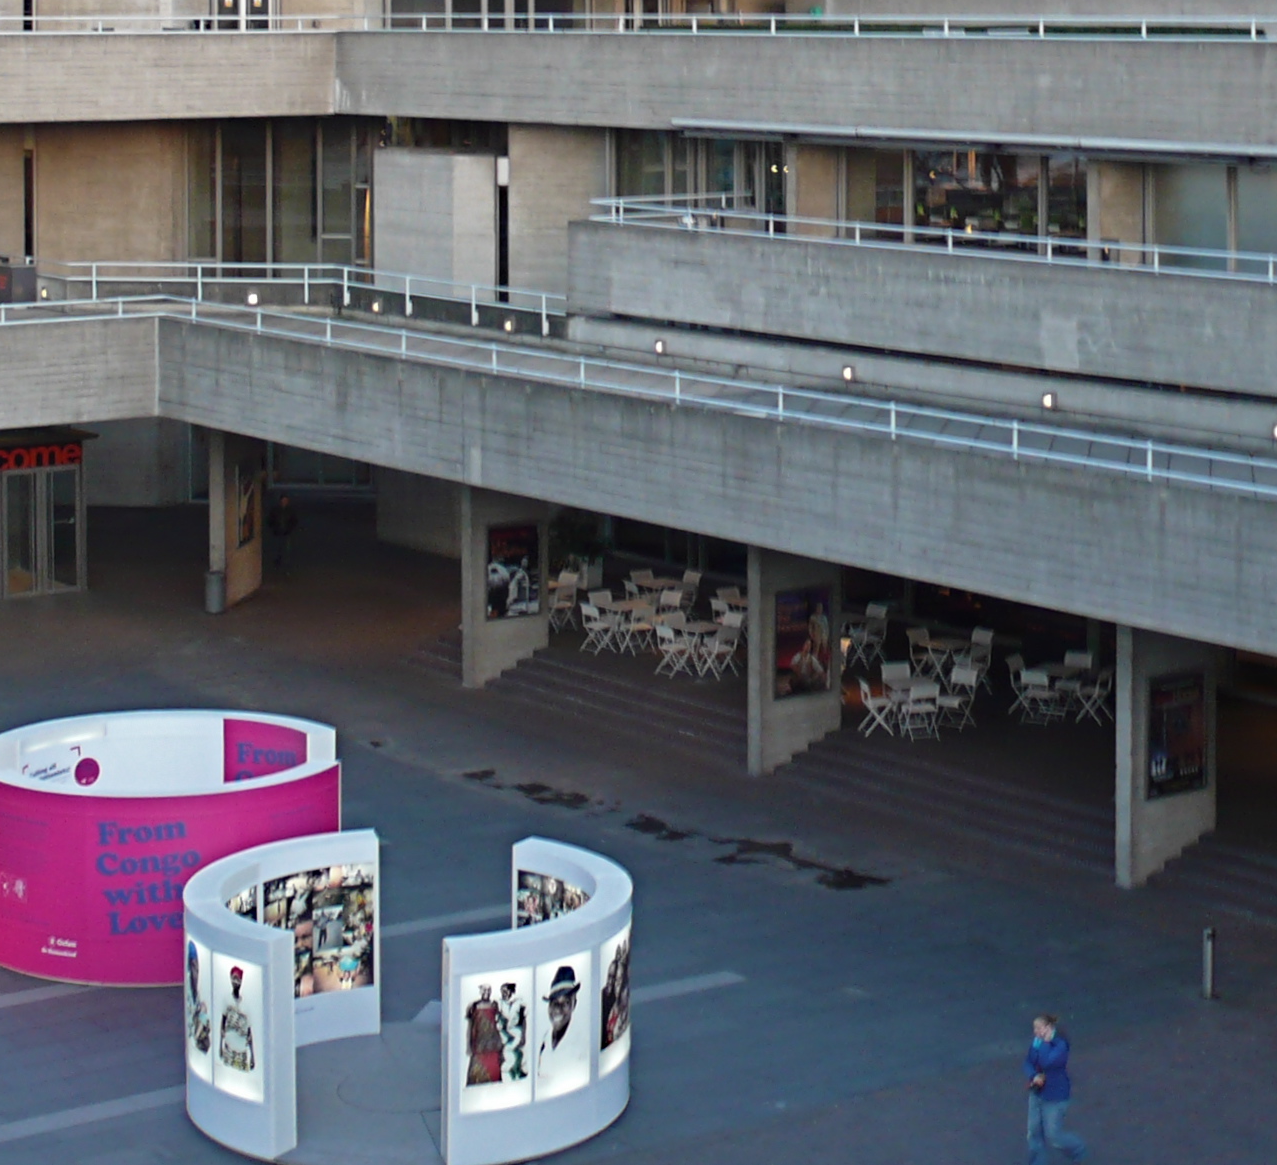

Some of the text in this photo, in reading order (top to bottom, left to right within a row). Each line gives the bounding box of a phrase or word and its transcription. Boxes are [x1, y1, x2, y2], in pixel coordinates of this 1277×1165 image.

[236, 740, 298, 767] From
[97, 820, 187, 846] From
[96, 850, 201, 876] Congo
[103, 878, 184, 906] with
[108, 911, 184, 936] Love
